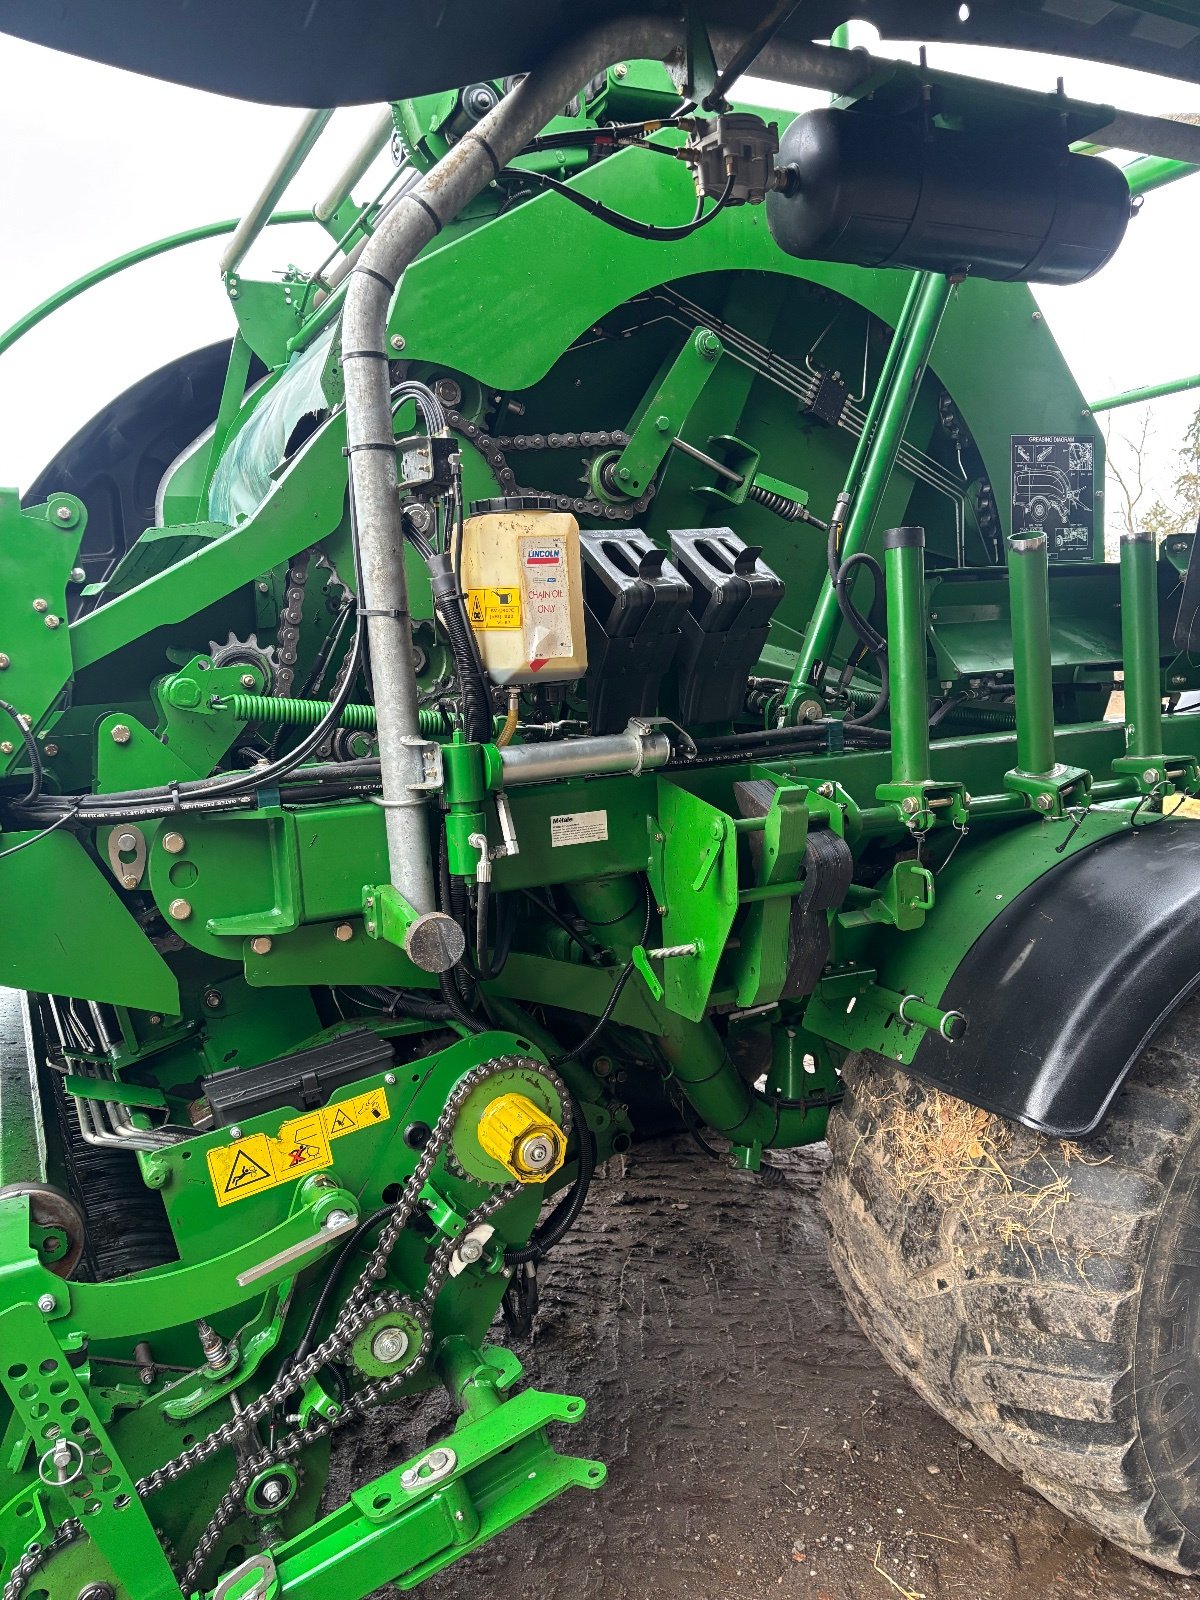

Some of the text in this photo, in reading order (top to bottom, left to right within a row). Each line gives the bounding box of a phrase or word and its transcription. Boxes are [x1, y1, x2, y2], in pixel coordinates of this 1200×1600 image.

[528, 589, 563, 599] CHAIN OIL
[537, 604, 556, 614] ONLY
